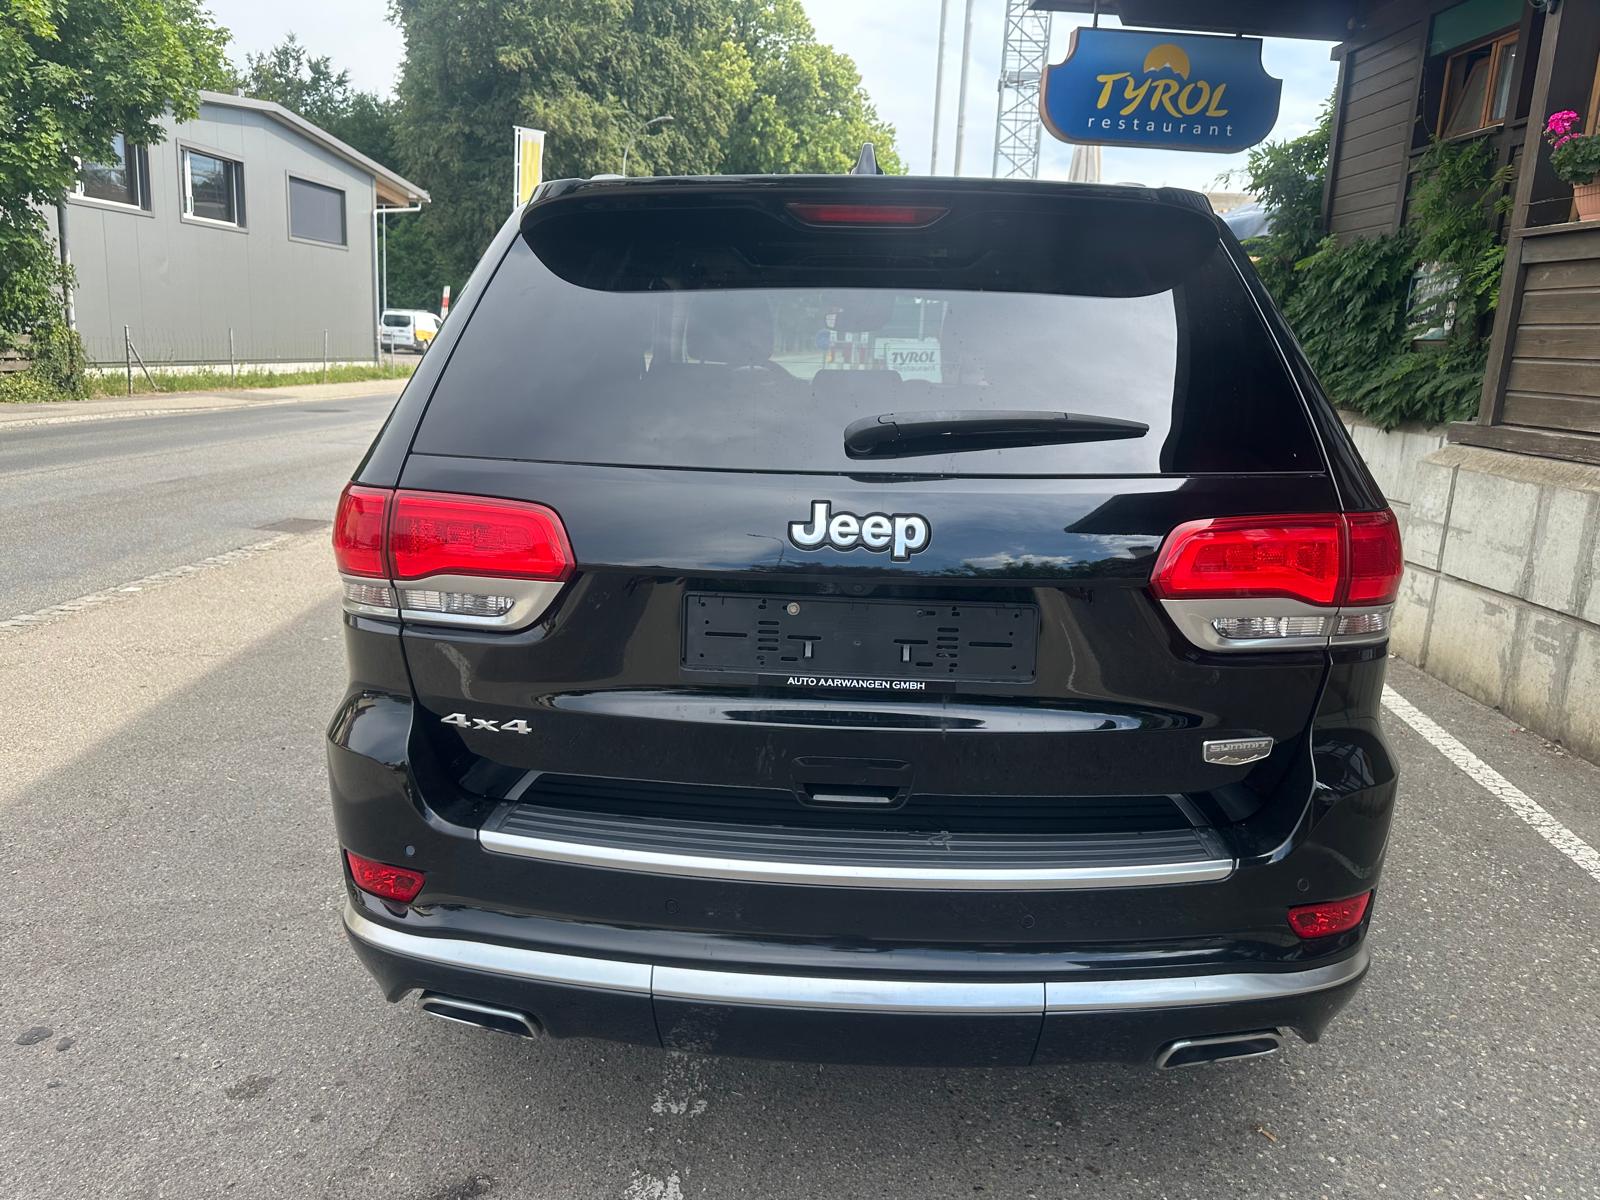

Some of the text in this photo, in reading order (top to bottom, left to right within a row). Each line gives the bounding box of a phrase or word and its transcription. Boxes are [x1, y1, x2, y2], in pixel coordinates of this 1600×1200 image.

[1096, 72, 1229, 118] TYROL
[1088, 117, 1233, 136] restaurant
[892, 351, 936, 365] TYROL
[789, 501, 931, 561] Jeep
[787, 676, 926, 690] AUTO AARWANGEN GMBH
[441, 712, 533, 735] 4x4
